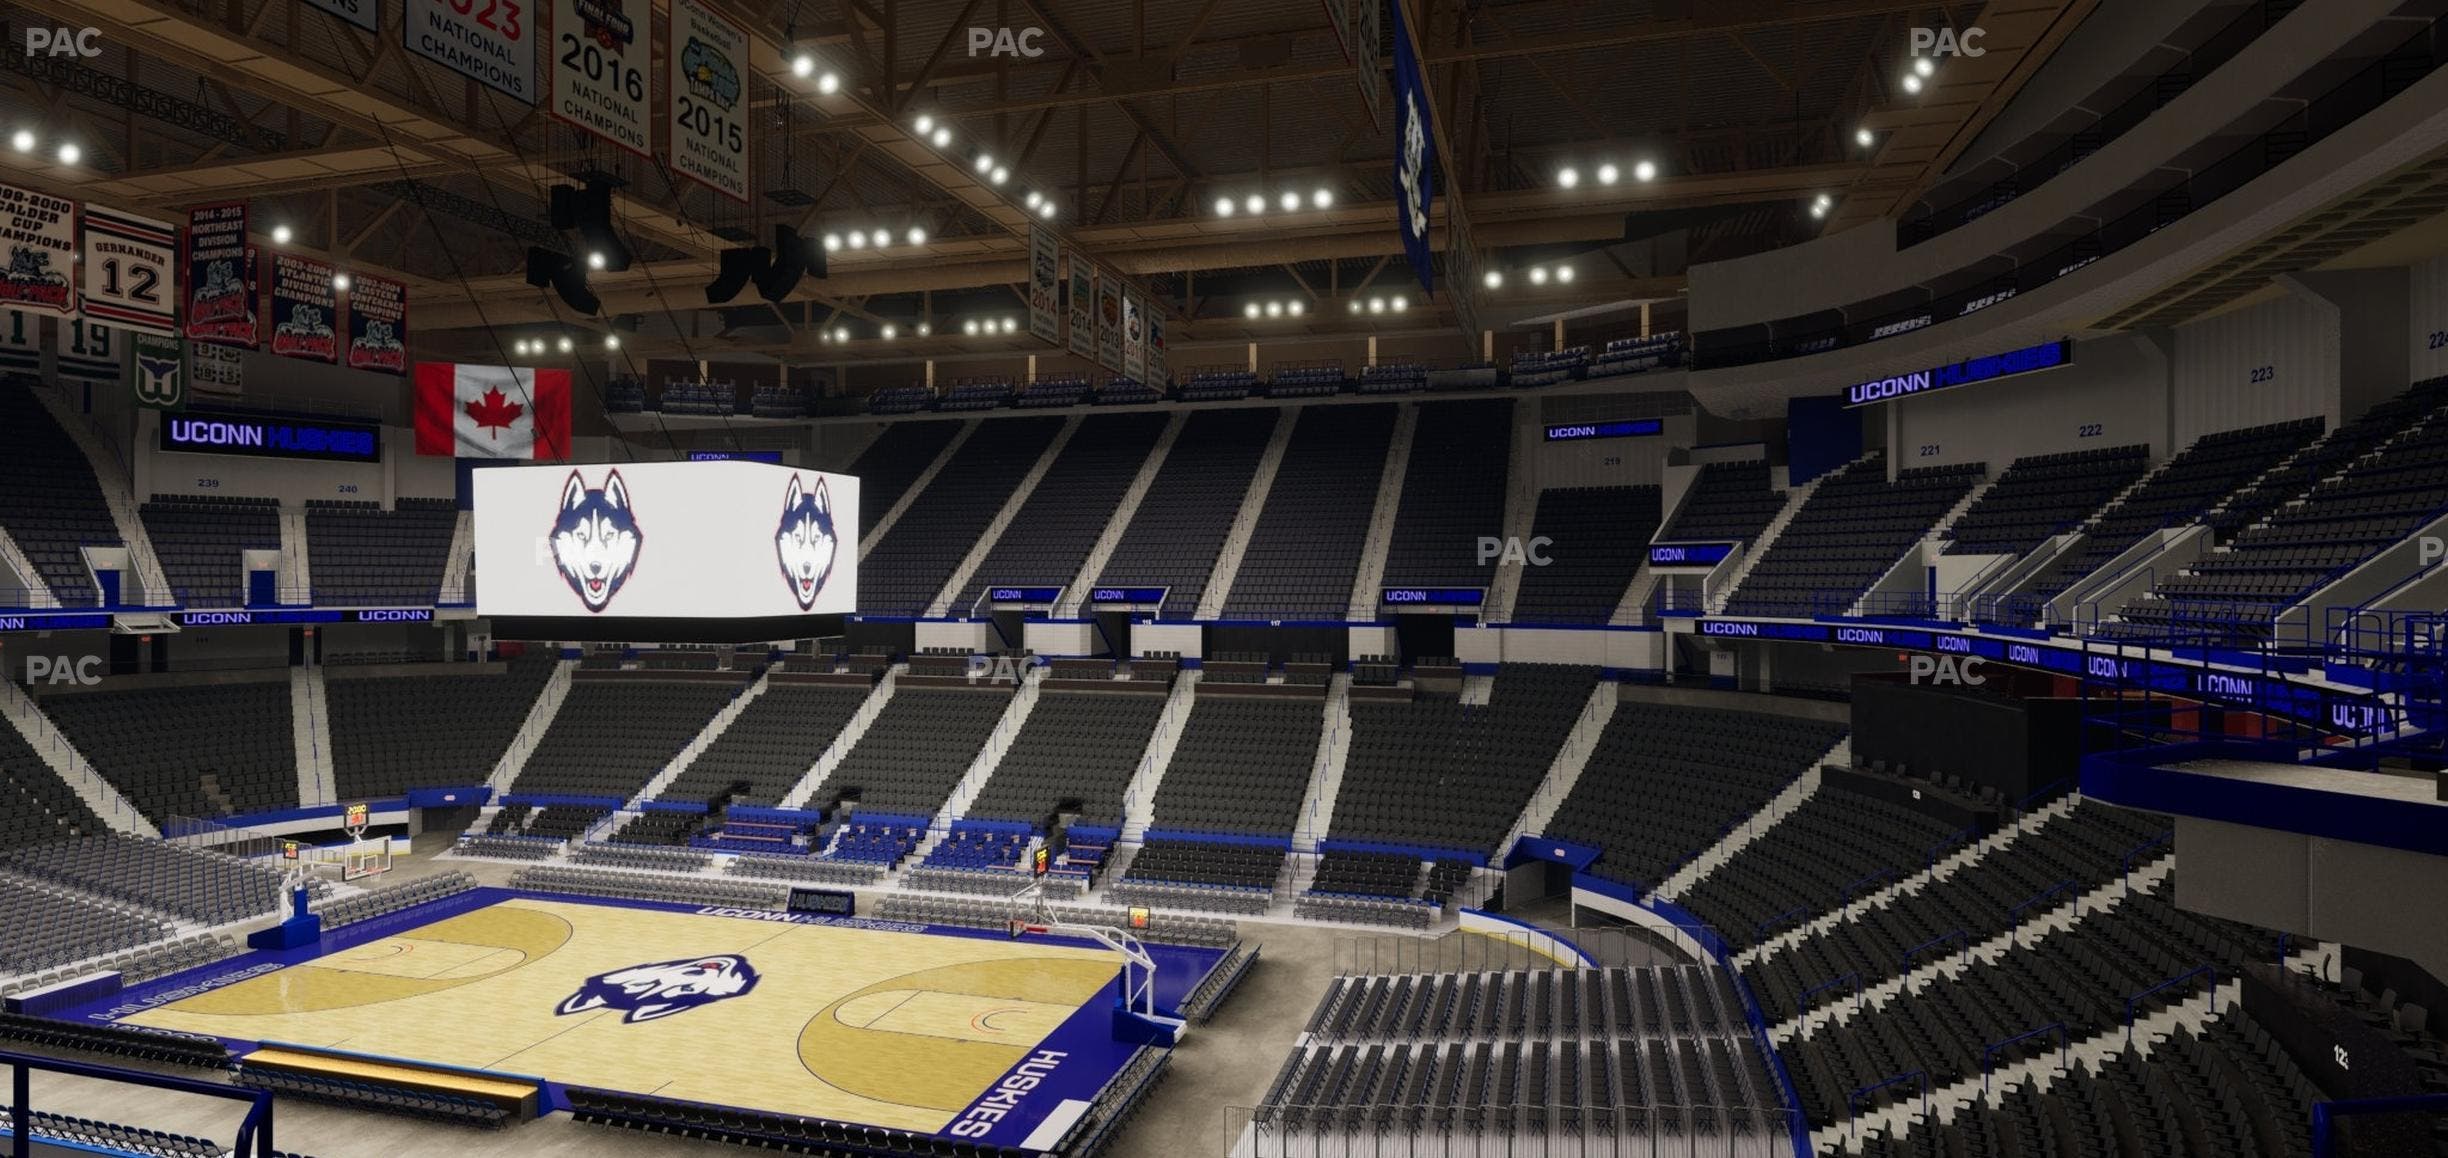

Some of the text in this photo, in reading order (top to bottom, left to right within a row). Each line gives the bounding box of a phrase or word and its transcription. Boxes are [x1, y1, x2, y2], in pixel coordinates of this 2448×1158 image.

[430, 11, 516, 66] NATIONAL
[421, 34, 522, 93] CHAMPIONS
[561, 33, 643, 102] 2016
[572, 80, 638, 124] NATIONAL
[564, 100, 644, 148] CHAMPIONS
[678, 96, 742, 153] 2015
[686, 138, 739, 173] NATIONAL
[680, 155, 743, 194] CHAMPIONS
[221, 207, 242, 218] 2015
[12, 217, 43, 231] CUP
[192, 221, 244, 235] NORTHEAST
[0, 227, 71, 250] AMPIONS
[199, 234, 237, 247] DIVISION
[95, 242, 165, 266] GERNANDER
[192, 247, 243, 261] CHAMPIONS
[102, 258, 160, 305] 12
[278, 267, 330, 285] ATLANTIC
[281, 278, 328, 295] DIVISION
[358, 284, 398, 301] EASTERN
[274, 287, 335, 308] CHAMPIONS
[350, 292, 404, 311] CONFERENCE
[1032, 288, 1057, 314] 2014
[352, 302, 402, 320] CHAMPIONS
[72, 318, 110, 356] 19
[137, 334, 180, 351] CHAMPIONS
[2251, 366, 2274, 383] 223
[1851, 370, 1930, 403] UCONN
[172, 419, 262, 446] UCONN
[1549, 426, 1596, 439] UCONN
[2079, 424, 2102, 437] 222
[1920, 445, 1940, 457] 221
[198, 479, 219, 488] 239
[338, 485, 358, 493] 240
[1652, 548, 1685, 561] UCONN
[992, 590, 1022, 600] UCONN
[1094, 590, 1124, 600] UCONN
[1386, 591, 1427, 601] UCONN
[183, 612, 251, 625] UCONN
[359, 609, 430, 621] UCONN
[1703, 622, 1758, 636] UCONN
[1837, 628, 1883, 644] UCONN
[1937, 636, 1970, 652] UCONN
[2009, 644, 2039, 664] UCONN
[696, 906, 801, 922] UCONN
[950, 1049, 1069, 1138] HUSKIES
